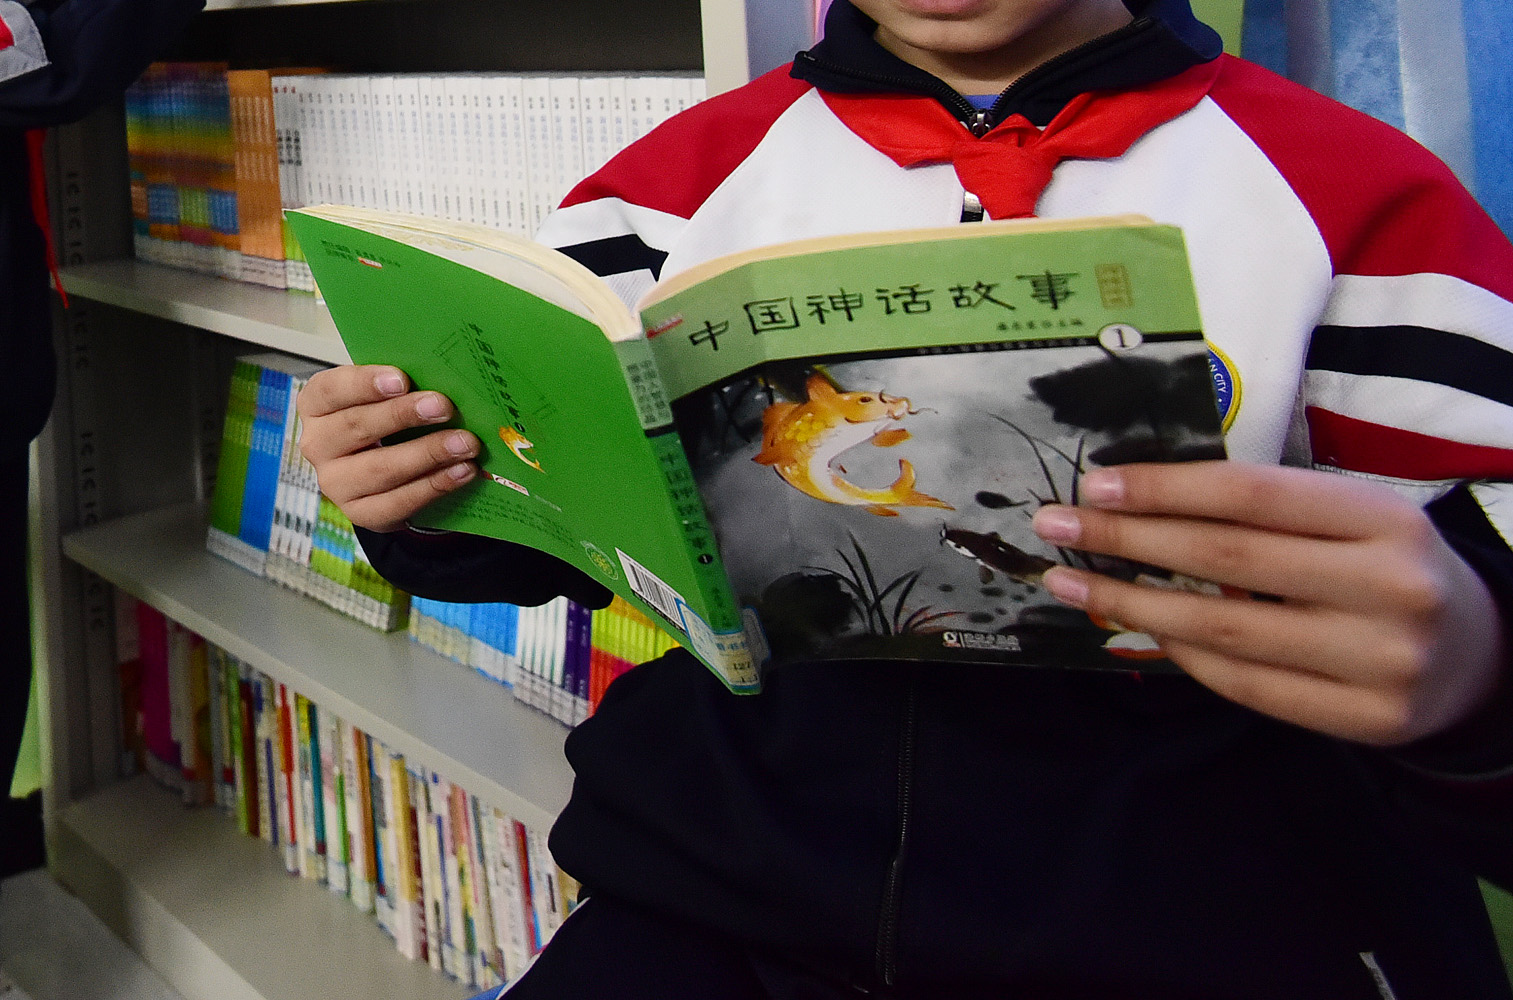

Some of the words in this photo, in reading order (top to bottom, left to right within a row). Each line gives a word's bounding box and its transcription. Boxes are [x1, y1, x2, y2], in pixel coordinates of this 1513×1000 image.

[688, 268, 1080, 351] 中国神话故事
